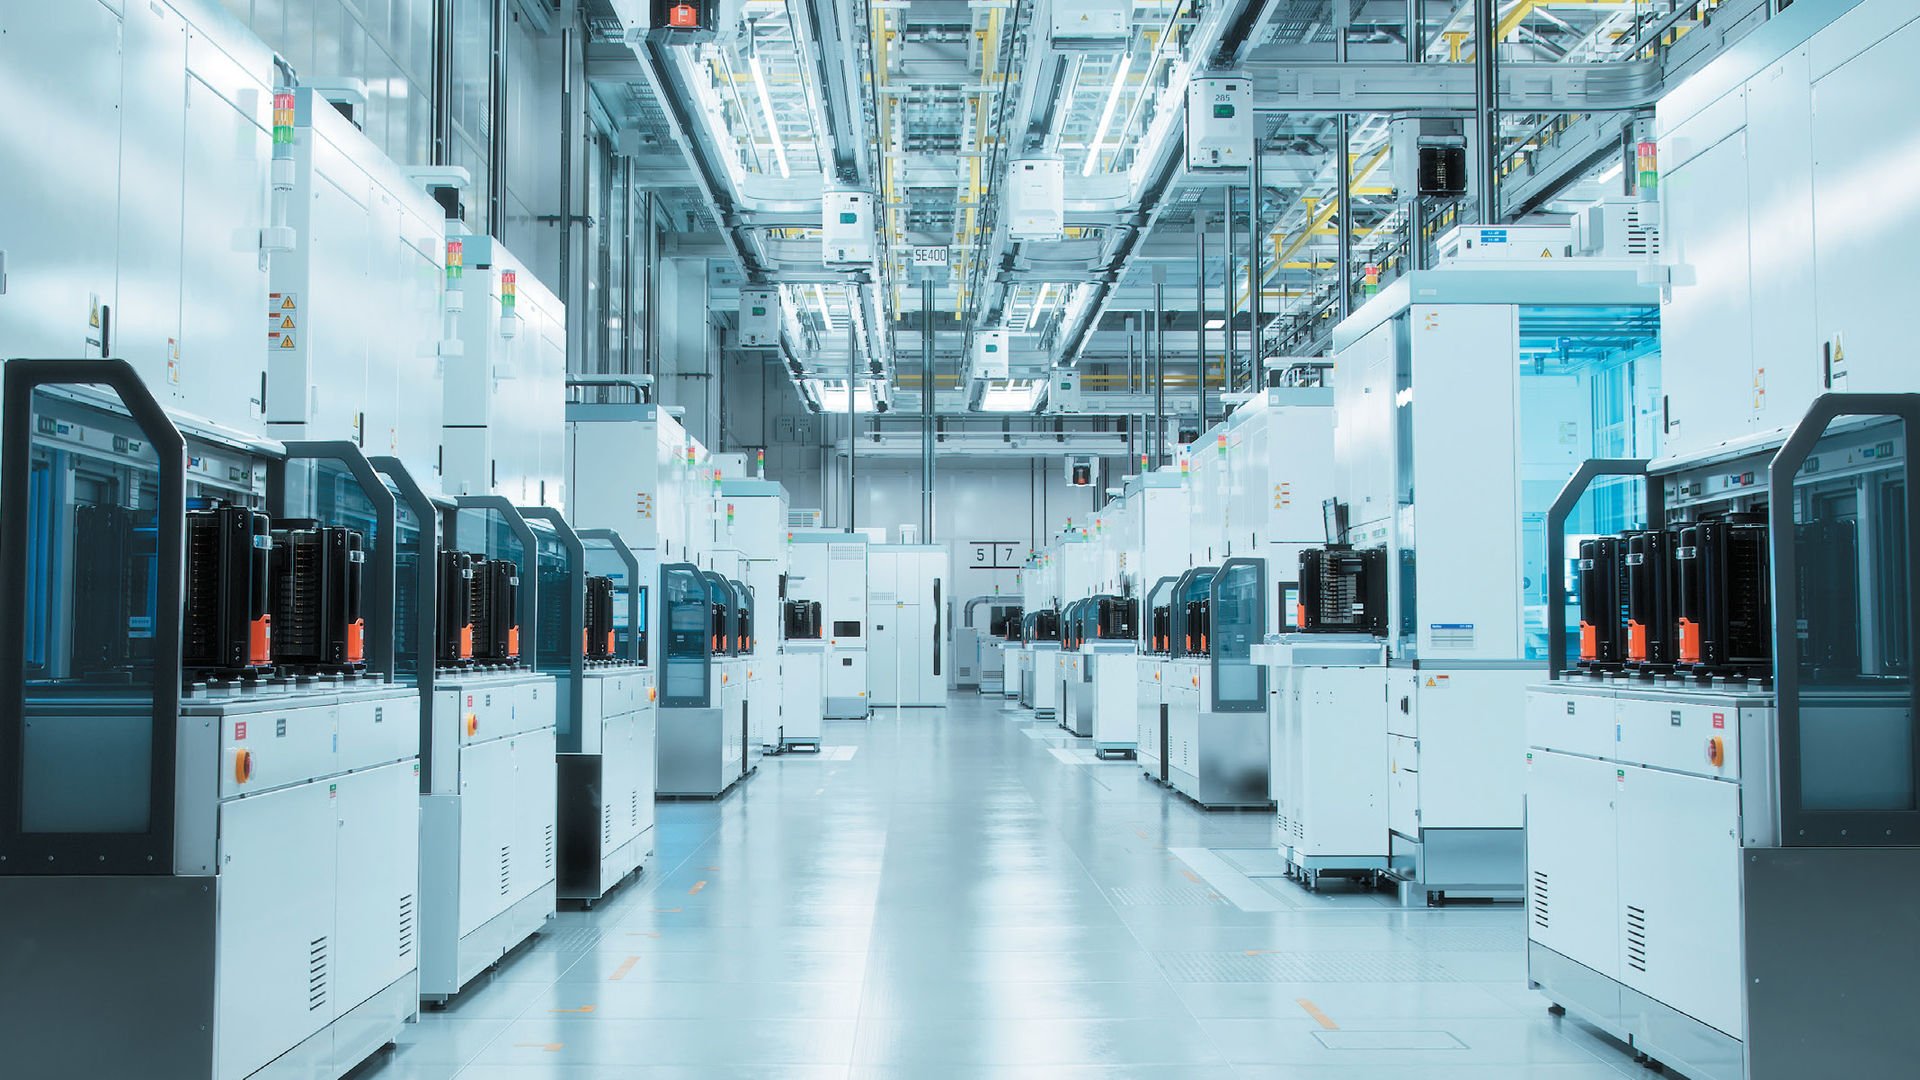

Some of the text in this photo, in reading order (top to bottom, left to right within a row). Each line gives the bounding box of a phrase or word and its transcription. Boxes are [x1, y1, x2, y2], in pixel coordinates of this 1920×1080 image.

[915, 249, 947, 262] SE400
[976, 548, 1013, 562] 5 7
